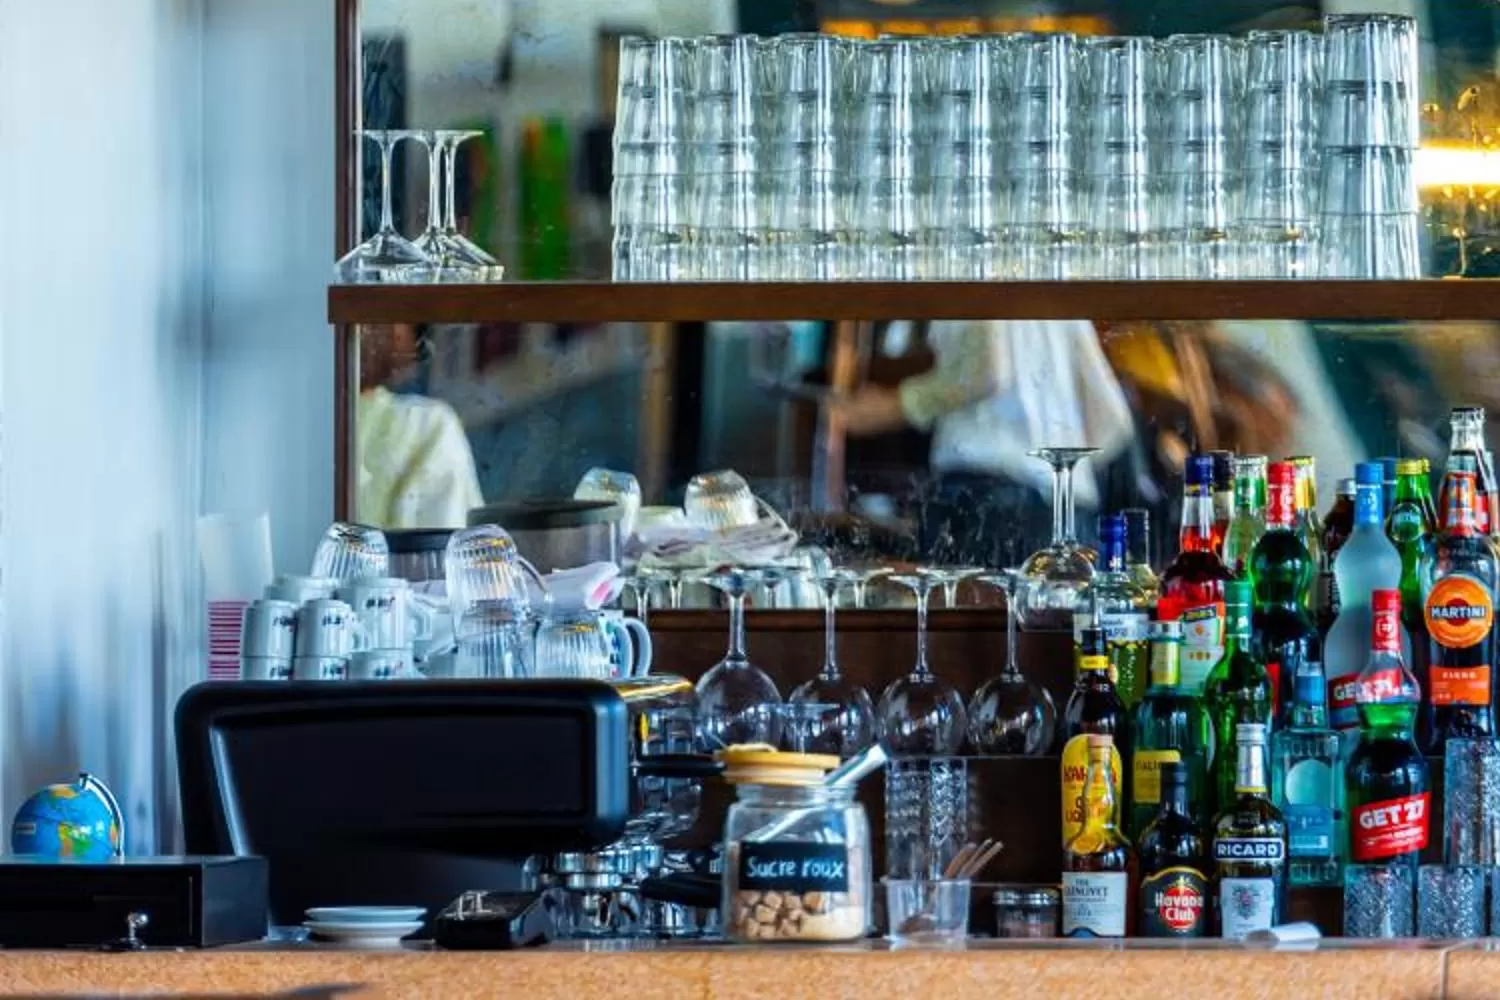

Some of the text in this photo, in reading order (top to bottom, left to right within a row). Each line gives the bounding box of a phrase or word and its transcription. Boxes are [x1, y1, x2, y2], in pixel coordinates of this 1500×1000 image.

[1431, 606, 1485, 618] MARTINI
[1360, 799, 1425, 829] GET 27
[1217, 843, 1278, 856] RICARD
[746, 855, 845, 879] Sucre roux
[1154, 891, 1204, 908] Havana
[1165, 907, 1195, 921] Club
